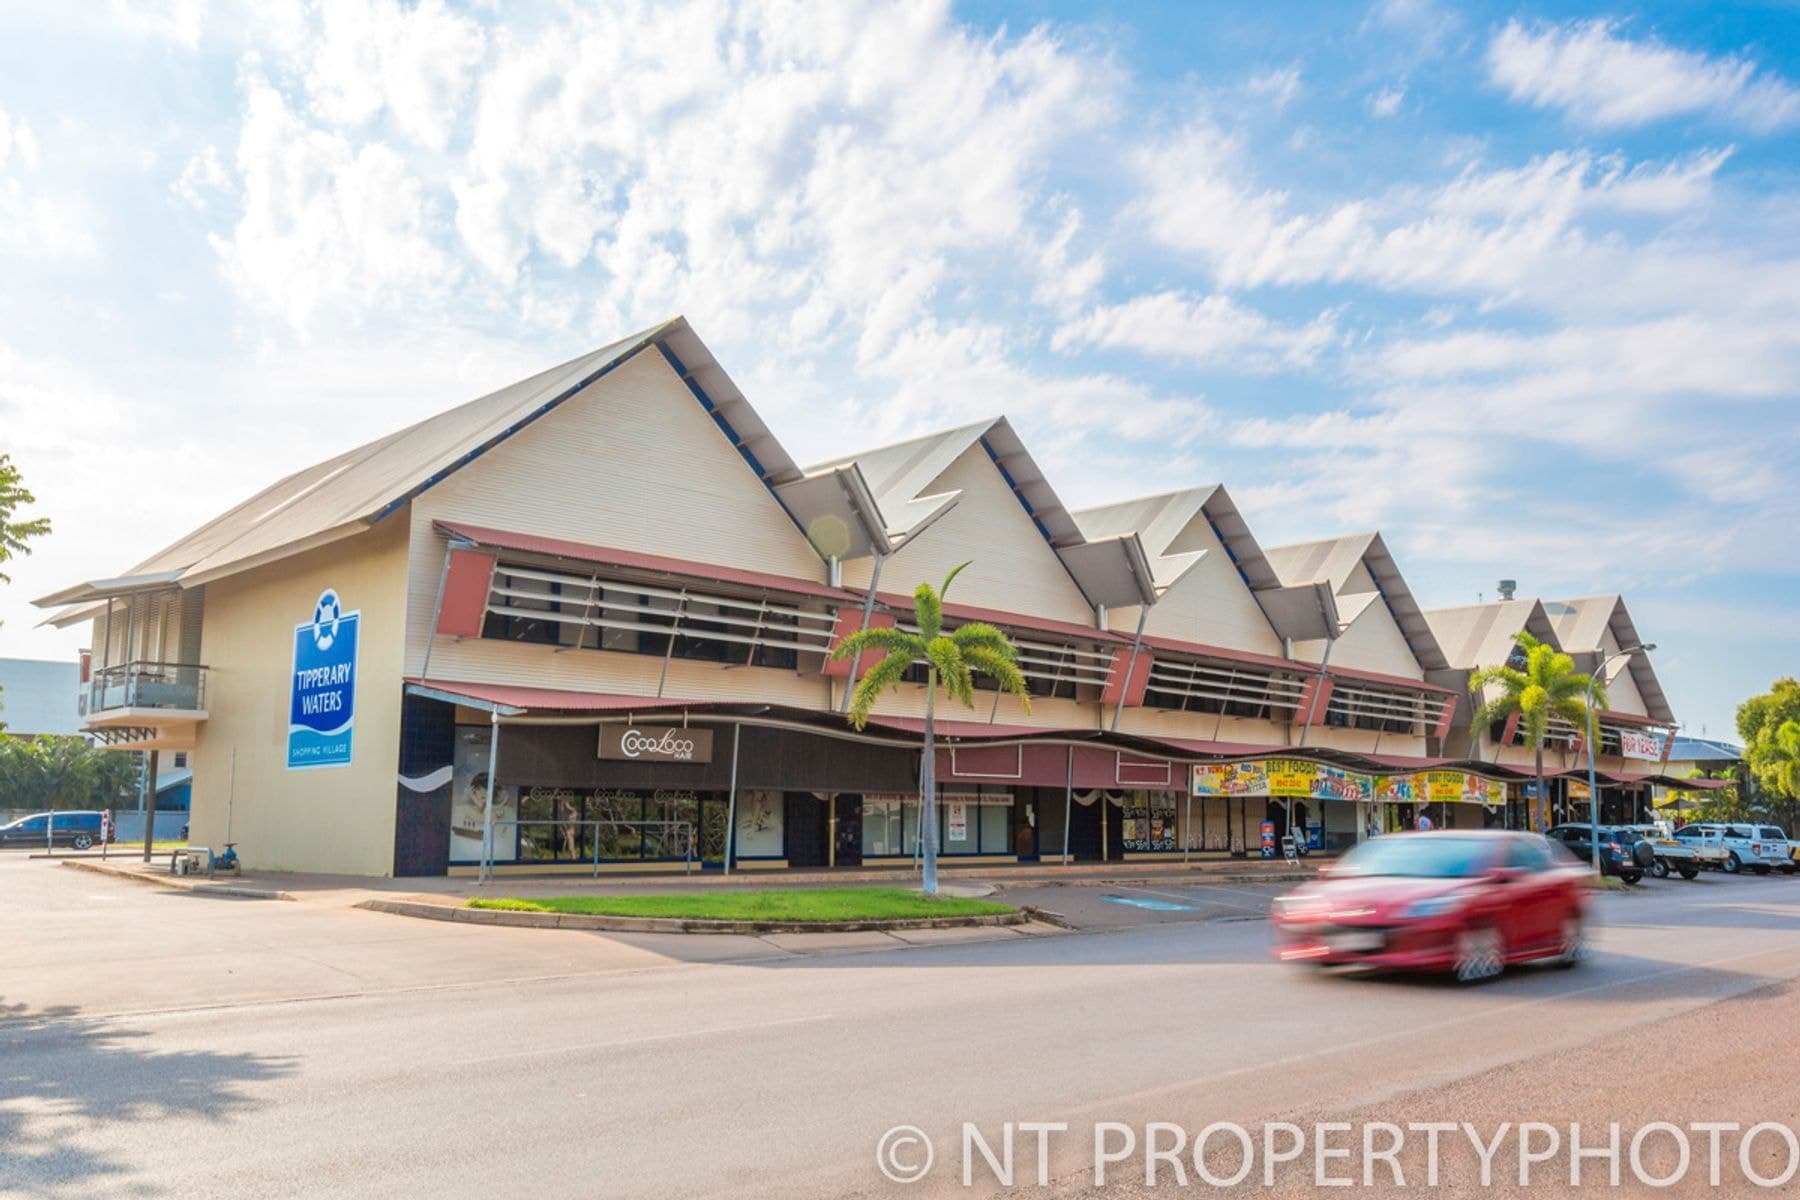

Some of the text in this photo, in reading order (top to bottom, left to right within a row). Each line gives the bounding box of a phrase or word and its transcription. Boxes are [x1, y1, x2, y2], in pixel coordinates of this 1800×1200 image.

[296, 662, 352, 690] TIPPERARY
[302, 691, 342, 715] WATERS
[292, 743, 347, 757] SHOPPING VILLAGE
[673, 752, 693, 760] HAIR
